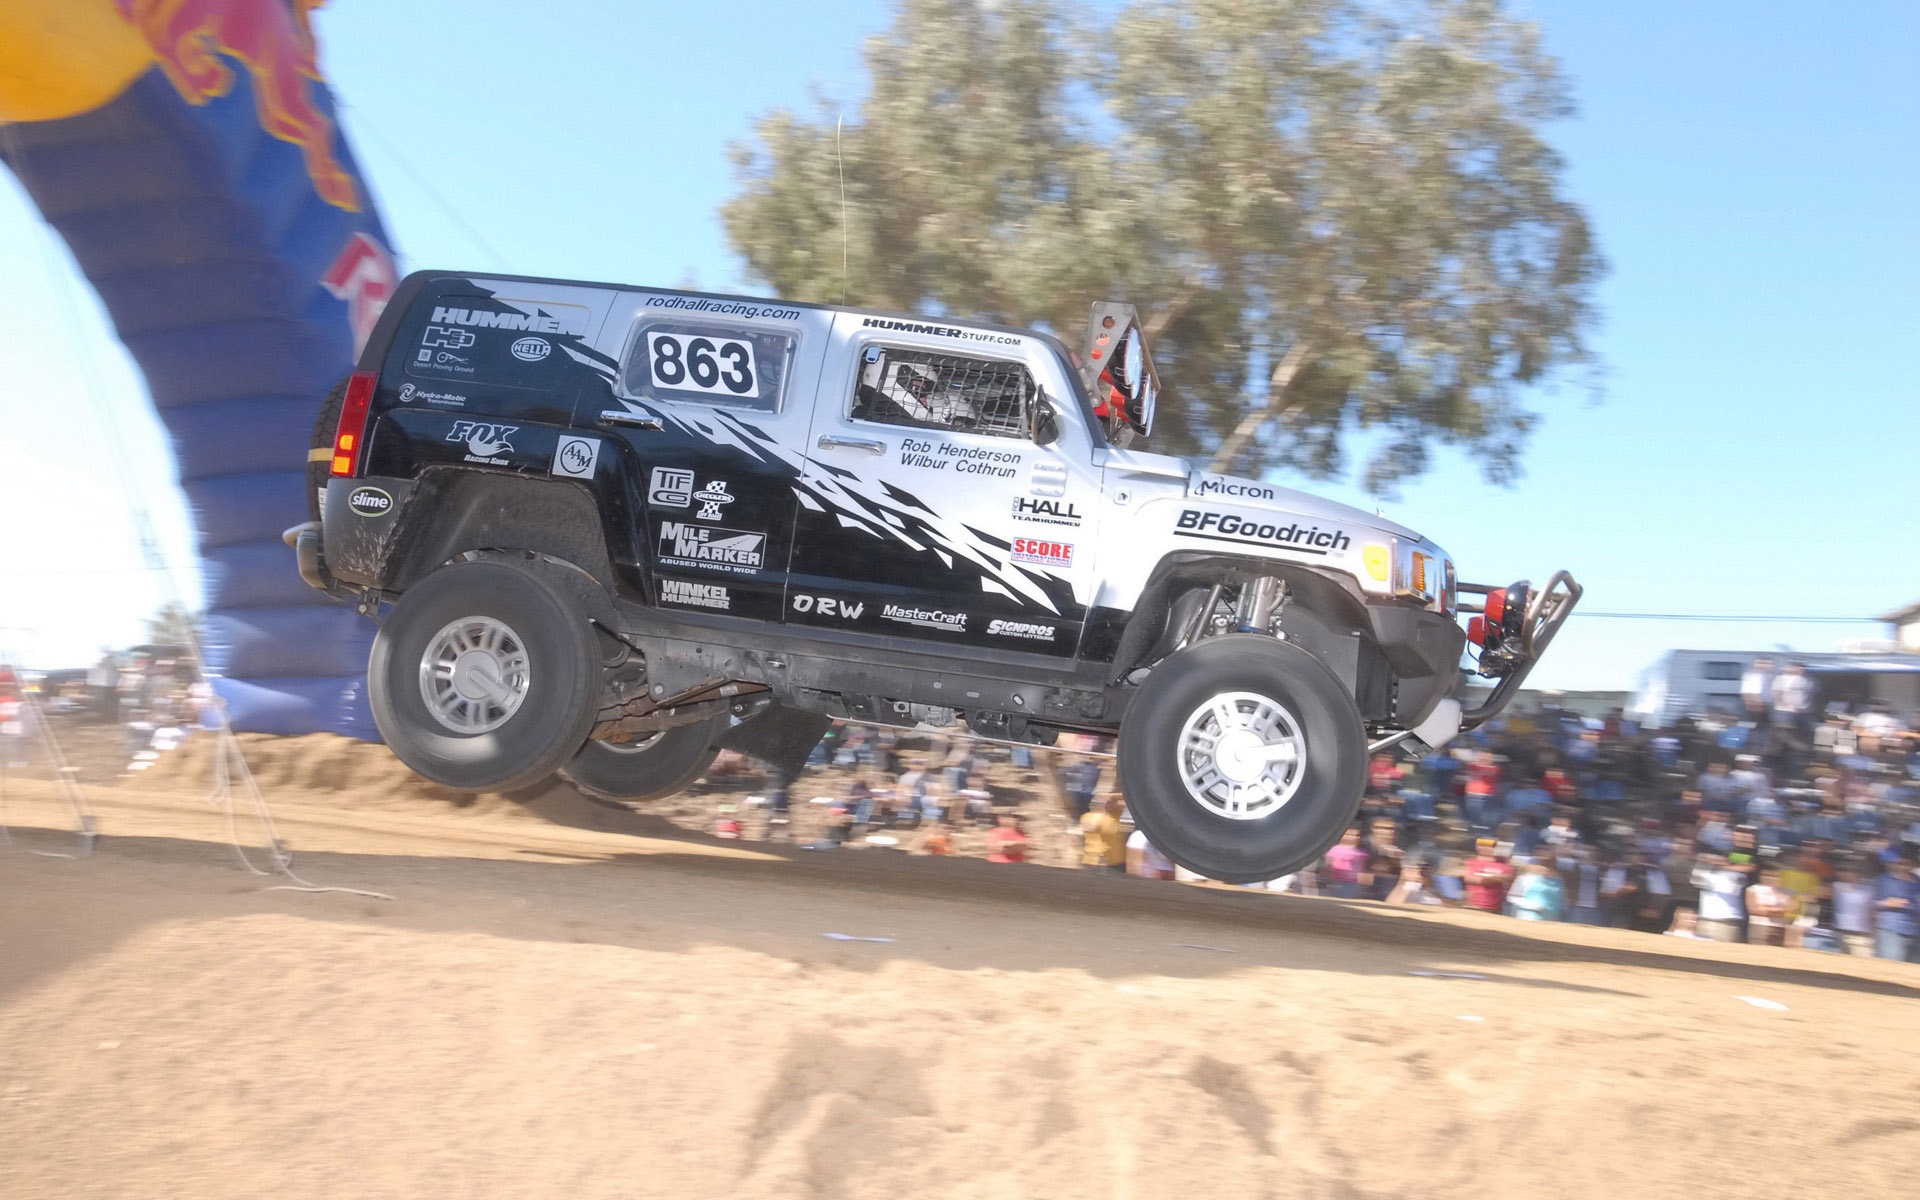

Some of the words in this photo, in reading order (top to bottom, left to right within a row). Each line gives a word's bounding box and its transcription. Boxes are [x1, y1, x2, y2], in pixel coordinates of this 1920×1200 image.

[645, 296, 800, 320] rodhallracing.com
[514, 343, 551, 357] HELLA
[433, 363, 453, 371] Proving
[653, 335, 754, 394] 863
[416, 390, 466, 402] Hydra-Matic
[427, 398, 465, 406] Transmissions
[446, 420, 519, 444] FOX
[563, 444, 593, 468] AAM
[900, 438, 931, 453] Rob
[937, 442, 1021, 464] Henderson
[901, 452, 948, 470] Wilbur
[956, 459, 1016, 478] Cothrun
[351, 491, 389, 509] slime
[1196, 479, 1274, 500] Micron
[1018, 497, 1082, 519] HALL
[660, 521, 710, 541] MILE
[1176, 509, 1351, 551] BFGoodrich
[674, 539, 761, 565] MARKER
[1013, 552, 1069, 562] INTERNATIONAL
[1014, 538, 1072, 559] SCORE
[660, 558, 697, 567] ABUSED
[698, 562, 731, 571] WORLD
[733, 567, 757, 575] WIDE
[662, 579, 730, 600] WINKEL
[661, 592, 730, 609] HUMMER
[793, 594, 864, 620] ORW
[883, 604, 968, 625] MasterCraft
[986, 619, 1055, 637] SIGNPROS
[999, 630, 1023, 638] CUSTOM
[1023, 633, 1055, 642] LETTERING
